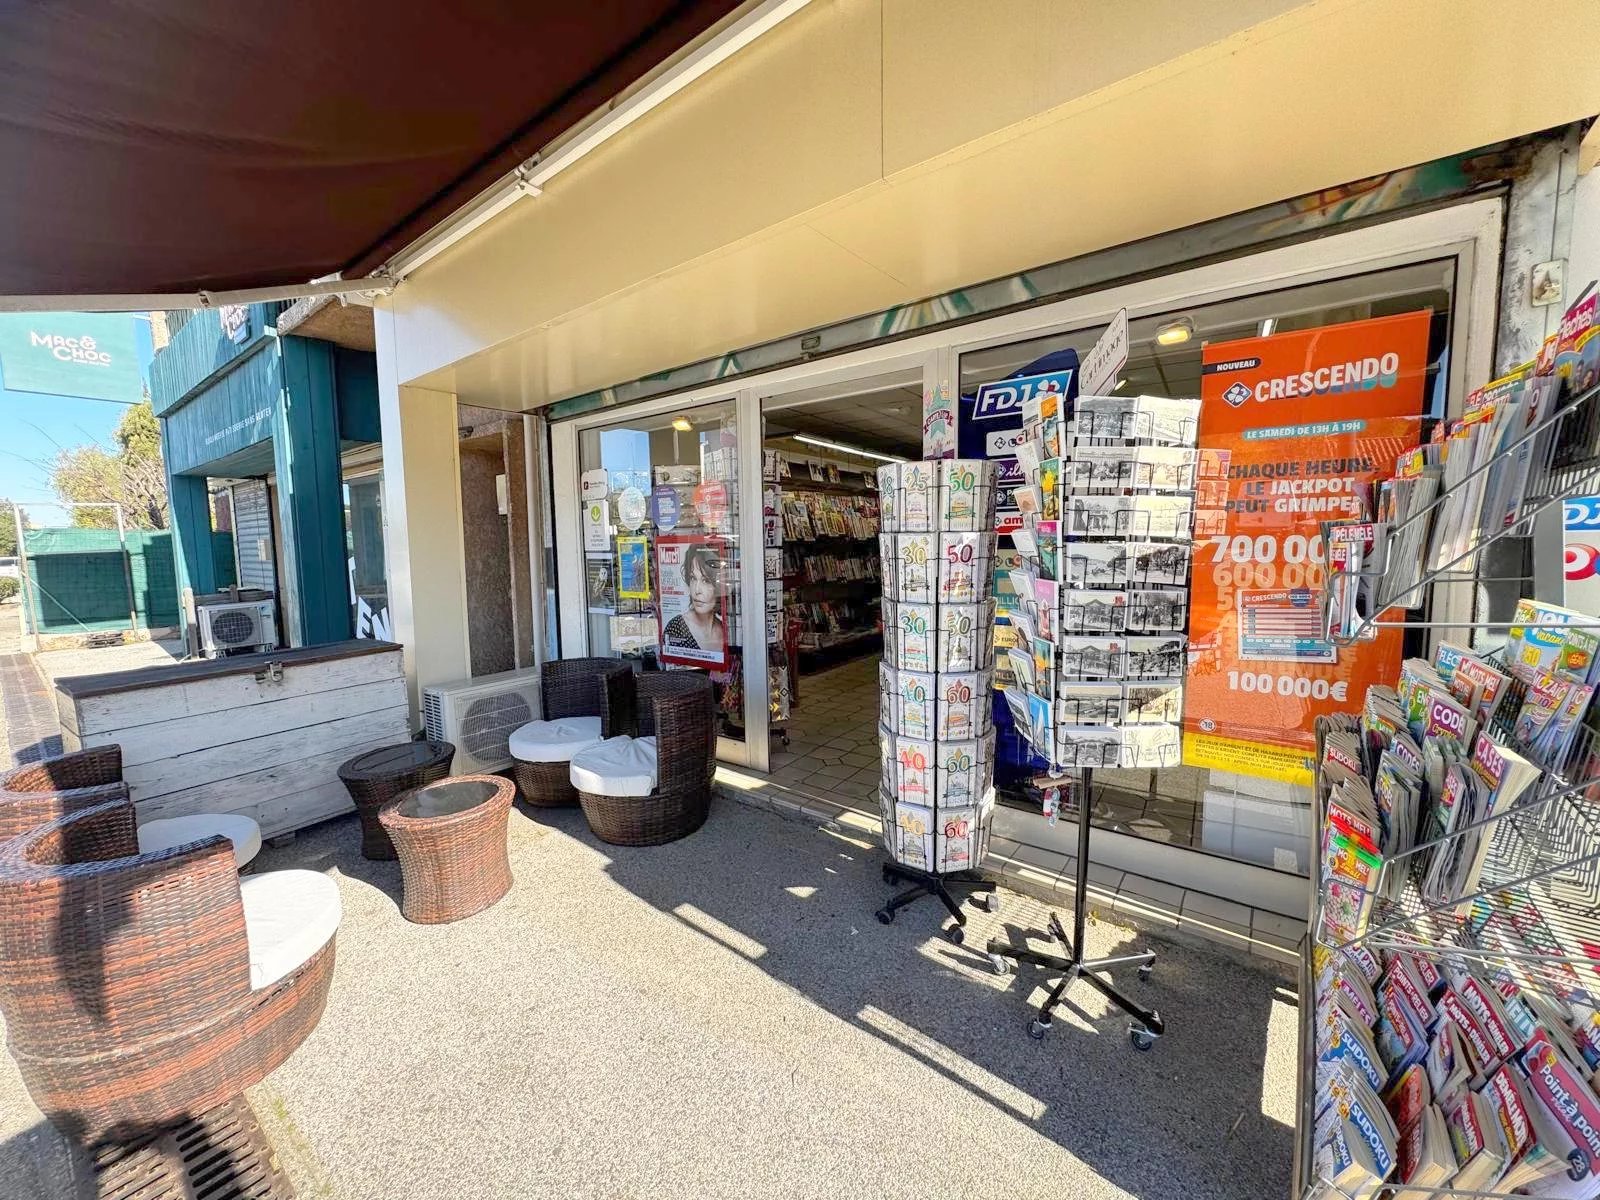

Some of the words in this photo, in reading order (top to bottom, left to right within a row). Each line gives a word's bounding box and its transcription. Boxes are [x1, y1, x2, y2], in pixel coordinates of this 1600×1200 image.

[1216, 359, 1255, 372] NOUVEAU
[1254, 352, 1399, 403] CRESCENDO
[980, 383, 1032, 413] FDJ
[1247, 431, 1258, 439] LE
[1259, 428, 1295, 438] SAMEDI
[1297, 426, 1309, 436] DE
[1312, 425, 1328, 435] 13H
[1332, 422, 1340, 432] À
[1342, 422, 1361, 432] 19H
[1227, 461, 1300, 479] CHAQUE
[905, 472, 927, 490] 25
[950, 472, 975, 492] 50
[1246, 481, 1264, 496] LE
[1270, 477, 1355, 496] JACKPOT
[1226, 499, 1267, 514] PEUT
[902, 546, 927, 565] 30
[947, 544, 973, 564] 50
[1211, 535, 1277, 563] 700
[1283, 535, 1325, 563] 00
[1213, 562, 1275, 588] 600
[1282, 562, 1325, 588] 00
[1252, 593, 1287, 602] CRESCENDO
[901, 616, 926, 634] 30
[947, 616, 971, 635] 50
[947, 686, 970, 704] 60
[1227, 671, 1273, 693] 100
[1277, 674, 1348, 701] 000€
[900, 751, 926, 769] 40
[947, 754, 970, 773] 60
[1329, 747, 1355, 771] SUDOKU
[1477, 736, 1503, 778] CASES
[1330, 805, 1351, 826] MOTS
[945, 820, 969, 839] 60
[1463, 985, 1491, 1020] MOTS
[1448, 1003, 1471, 1030] MOTS
[1342, 1031, 1380, 1087] SUDOKU
[1540, 1064, 1570, 1104] Point
[1567, 1101, 1578, 1117] à
[1573, 1115, 1600, 1158] poin
[1350, 1103, 1389, 1169] SUDOKU
